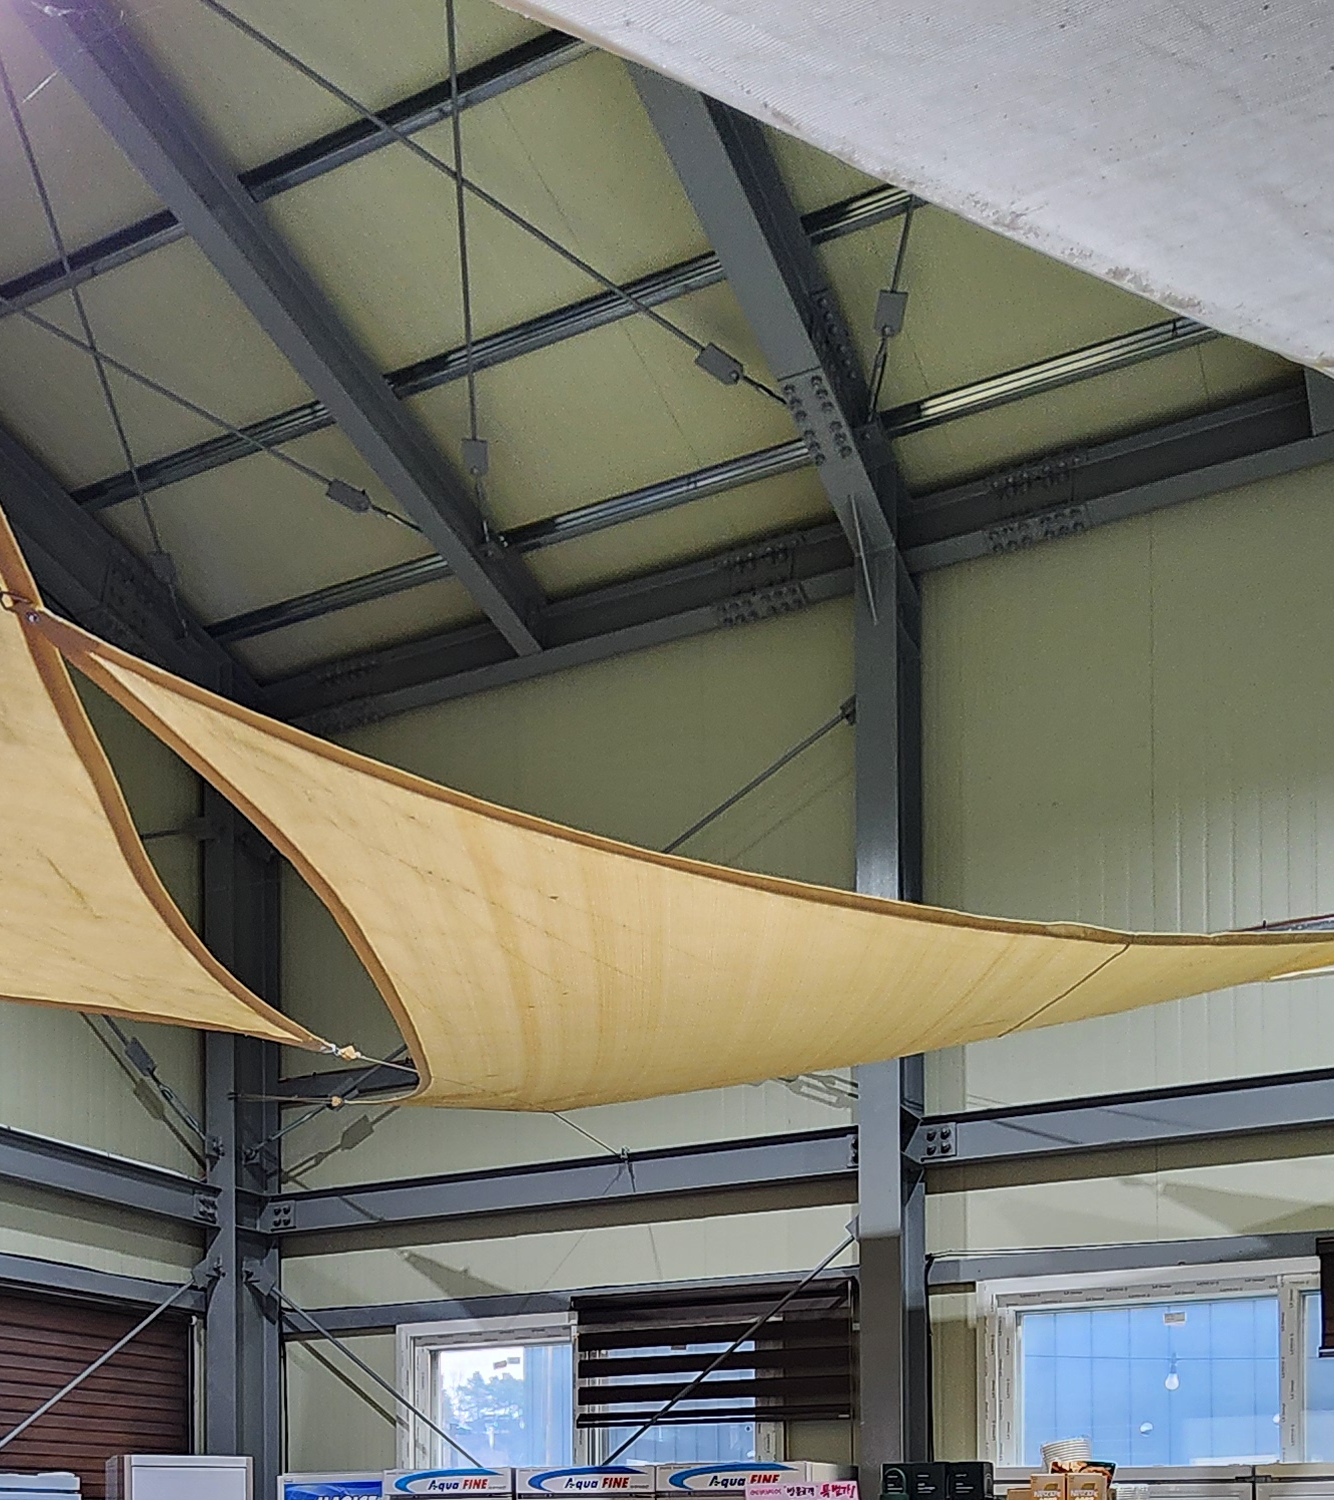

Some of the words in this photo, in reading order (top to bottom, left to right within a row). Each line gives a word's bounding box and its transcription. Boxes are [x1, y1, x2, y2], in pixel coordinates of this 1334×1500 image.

[427, 1478, 461, 1491] Aqua
[462, 1477, 489, 1490] FINE
[564, 1477, 600, 1491] Aqua
[601, 1477, 630, 1489] FINE
[708, 1475, 748, 1489] Aqua
